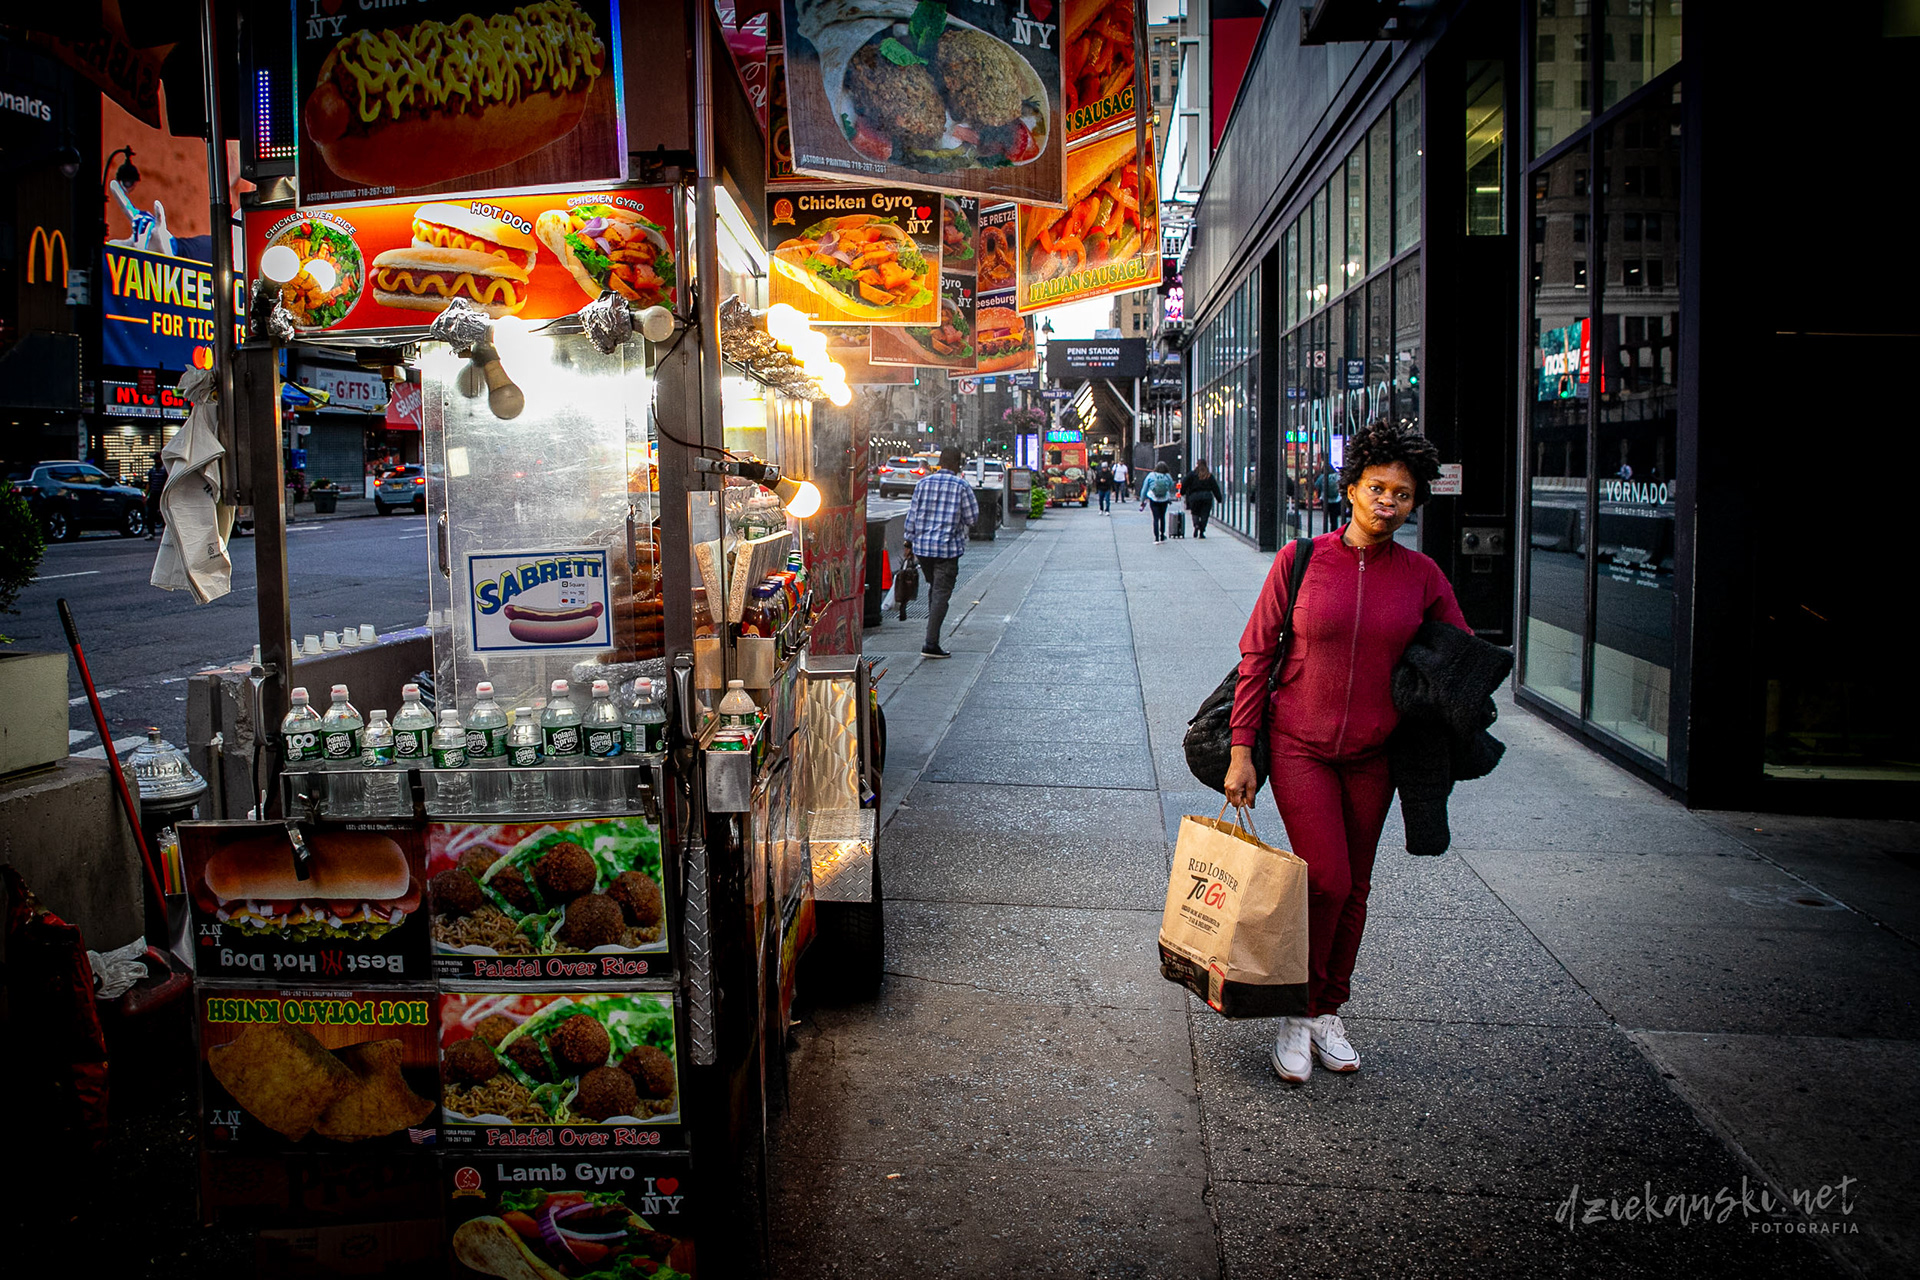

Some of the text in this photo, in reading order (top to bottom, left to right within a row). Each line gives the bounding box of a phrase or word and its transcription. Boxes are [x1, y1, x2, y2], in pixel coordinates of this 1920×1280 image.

[306, 15, 347, 40] NY
[1012, 17, 1056, 50] NY
[1074, 87, 1136, 130] SAUSAG
[330, 189, 357, 199] PRINTING
[565, 195, 644, 211] CHICKEN GYRO
[797, 193, 913, 212] Chicken Gyro
[909, 206, 917, 220] I
[960, 199, 975, 210] NY
[264, 210, 357, 240] CHICKEN OVER RICE
[470, 201, 534, 234] HOT DOG
[990, 208, 1017, 225] PRETZE
[907, 220, 934, 235] NY
[106, 252, 215, 311] YANKEE
[1030, 257, 1148, 302] ITALIAN SAUSAGE
[957, 298, 973, 308] NY
[151, 311, 183, 337] FOR
[1067, 347, 1120, 355] PENN STATION
[1606, 480, 1668, 505] VORNADO
[475, 557, 602, 615] SABRETT
[326, 732, 350, 745] Poland
[552, 728, 577, 741] Poland
[554, 736, 578, 749] Spring
[589, 732, 611, 744] Poland
[327, 740, 351, 753] Spring
[590, 739, 612, 750] Spring
[1188, 857, 1239, 892] RED LOBSTER
[1187, 874, 1227, 909] To Go
[199, 924, 223, 935] NY
[219, 948, 266, 973] Dog
[272, 954, 317, 973] Hot
[347, 954, 404, 973] Best
[473, 957, 648, 977] Falafel Over Rice
[207, 997, 429, 1025] HOT POTATO KNISH
[210, 1110, 241, 1125] NY
[486, 1127, 661, 1147] Falafel Over Rice
[497, 1162, 636, 1185] Lamb Gyro
[643, 1177, 656, 1196] I
[641, 1196, 684, 1215] NY
